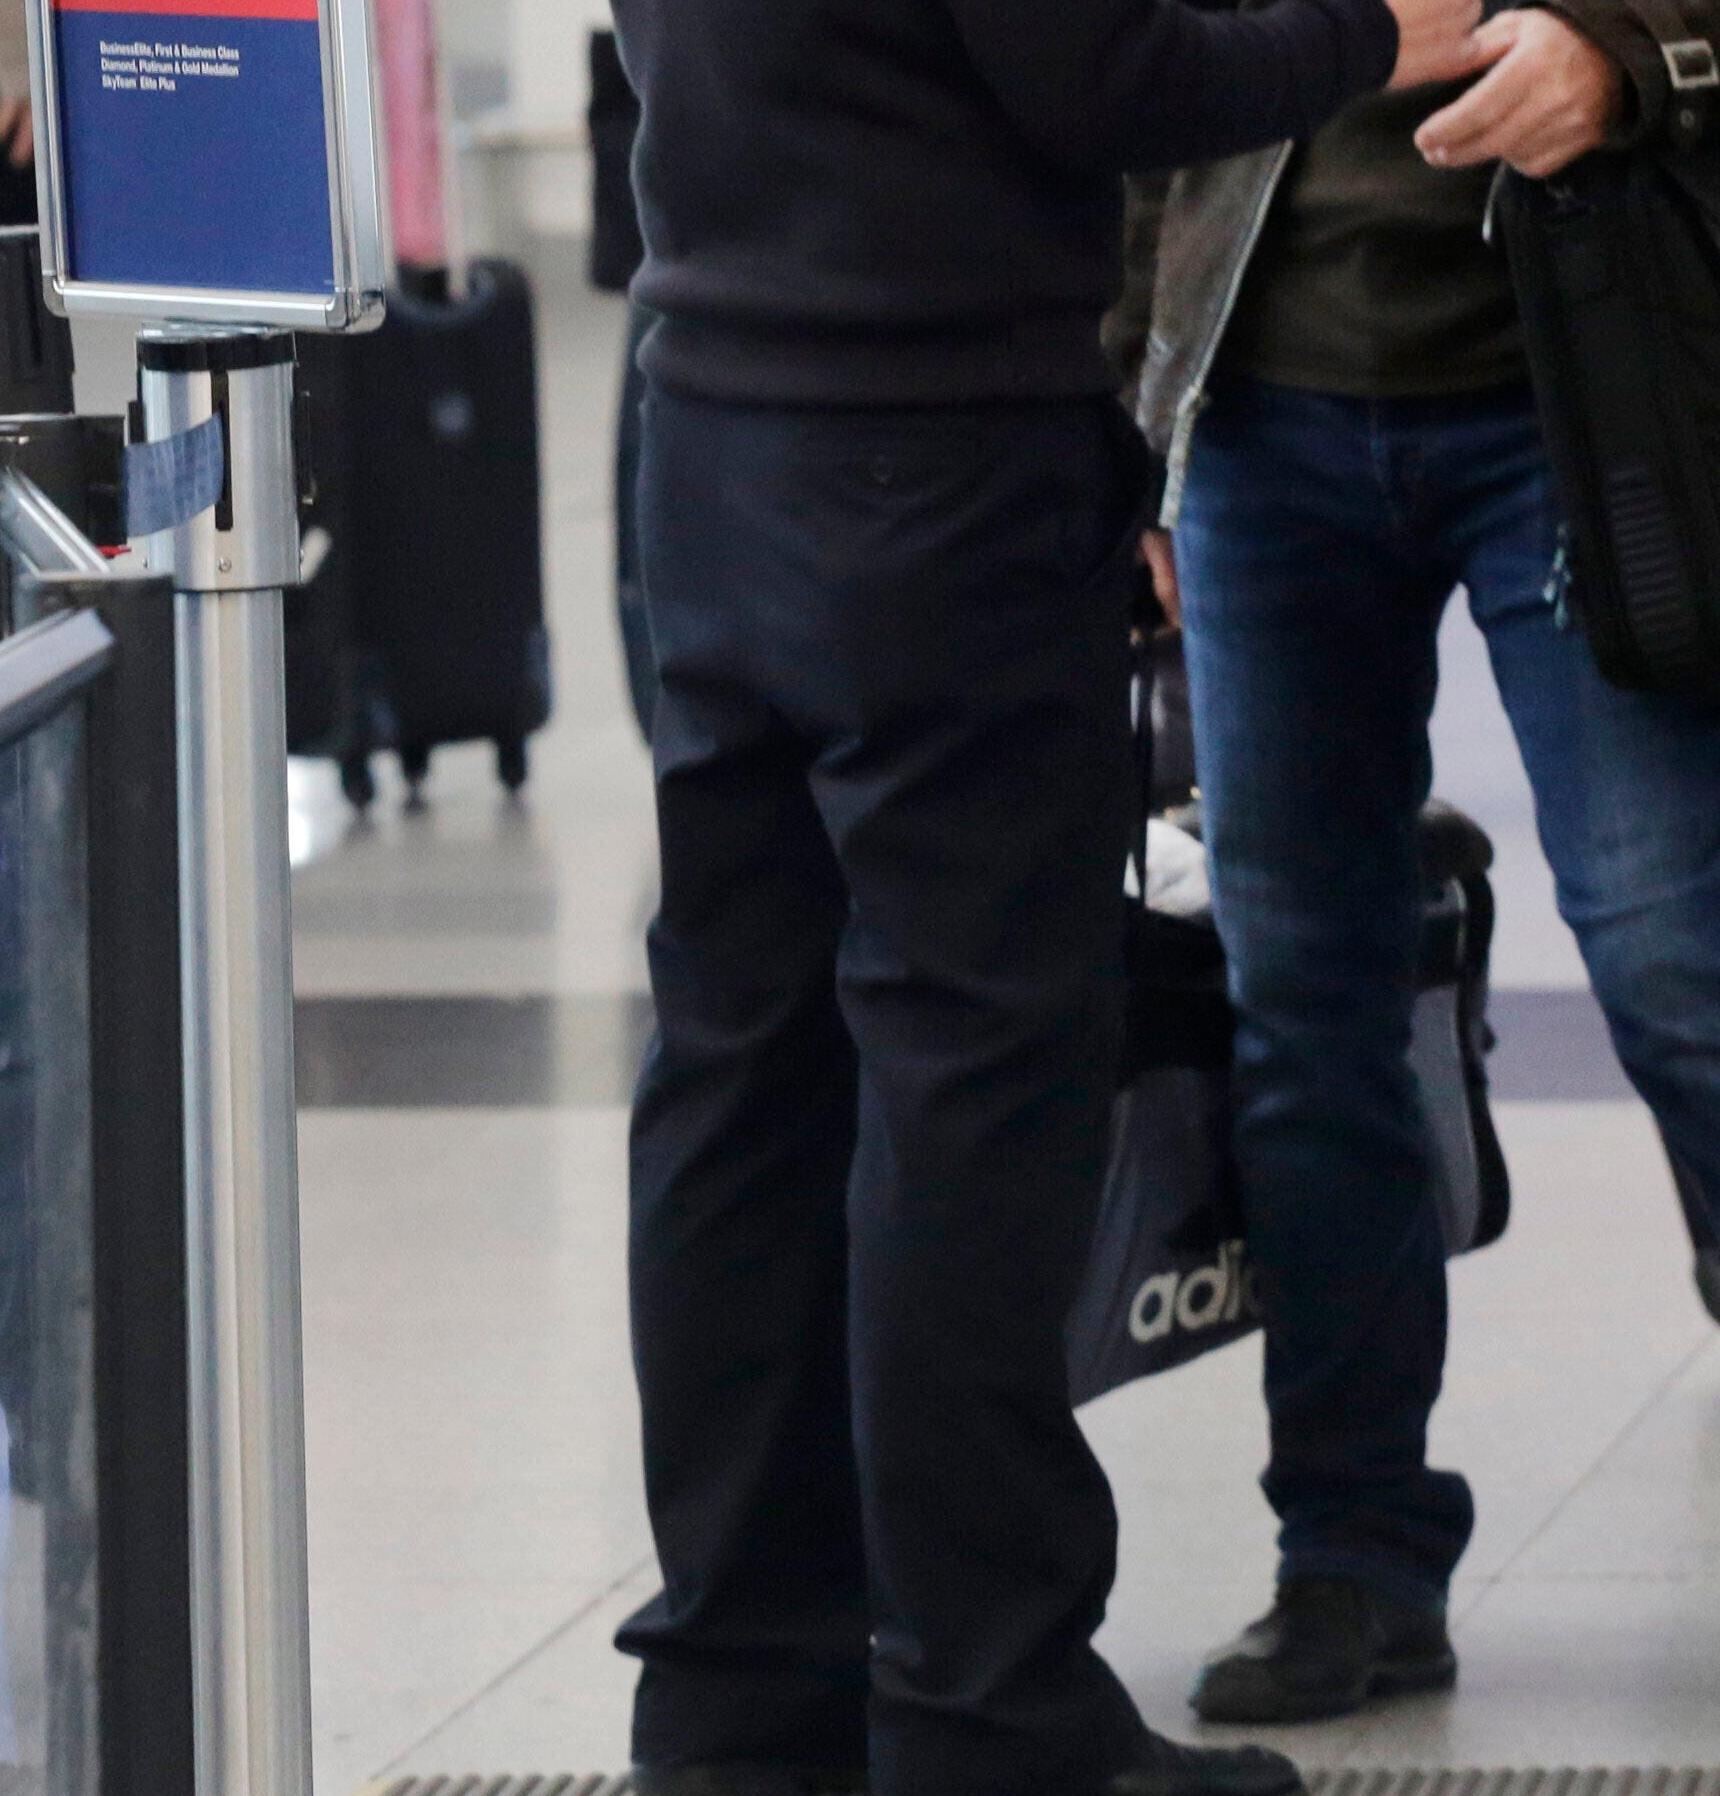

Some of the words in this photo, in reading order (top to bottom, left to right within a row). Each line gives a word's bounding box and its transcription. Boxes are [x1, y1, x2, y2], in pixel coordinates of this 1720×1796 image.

[181, 44, 217, 59] Business
[218, 45, 240, 61] Class
[139, 59, 173, 74] Platinum
[181, 60, 201, 76] Gold
[158, 76, 176, 92] Plus
[1128, 1238, 1248, 1343] adi
